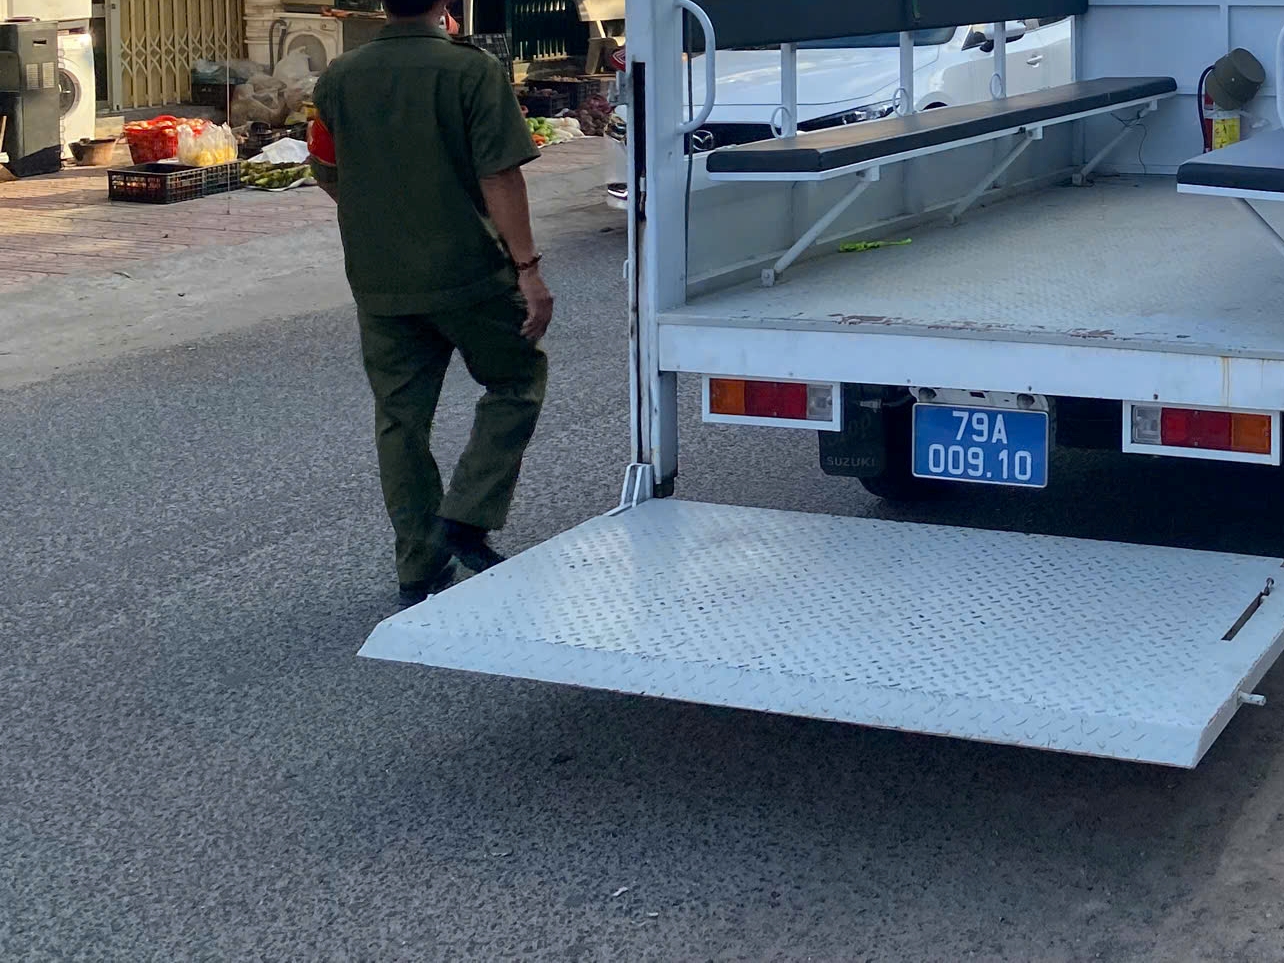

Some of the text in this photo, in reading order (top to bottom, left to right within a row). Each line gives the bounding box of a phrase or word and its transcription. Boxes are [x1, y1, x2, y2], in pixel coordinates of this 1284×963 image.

[952, 410, 1008, 445] 79A
[825, 455, 877, 468] SUZUKI
[928, 443, 1032, 481] 009.10
